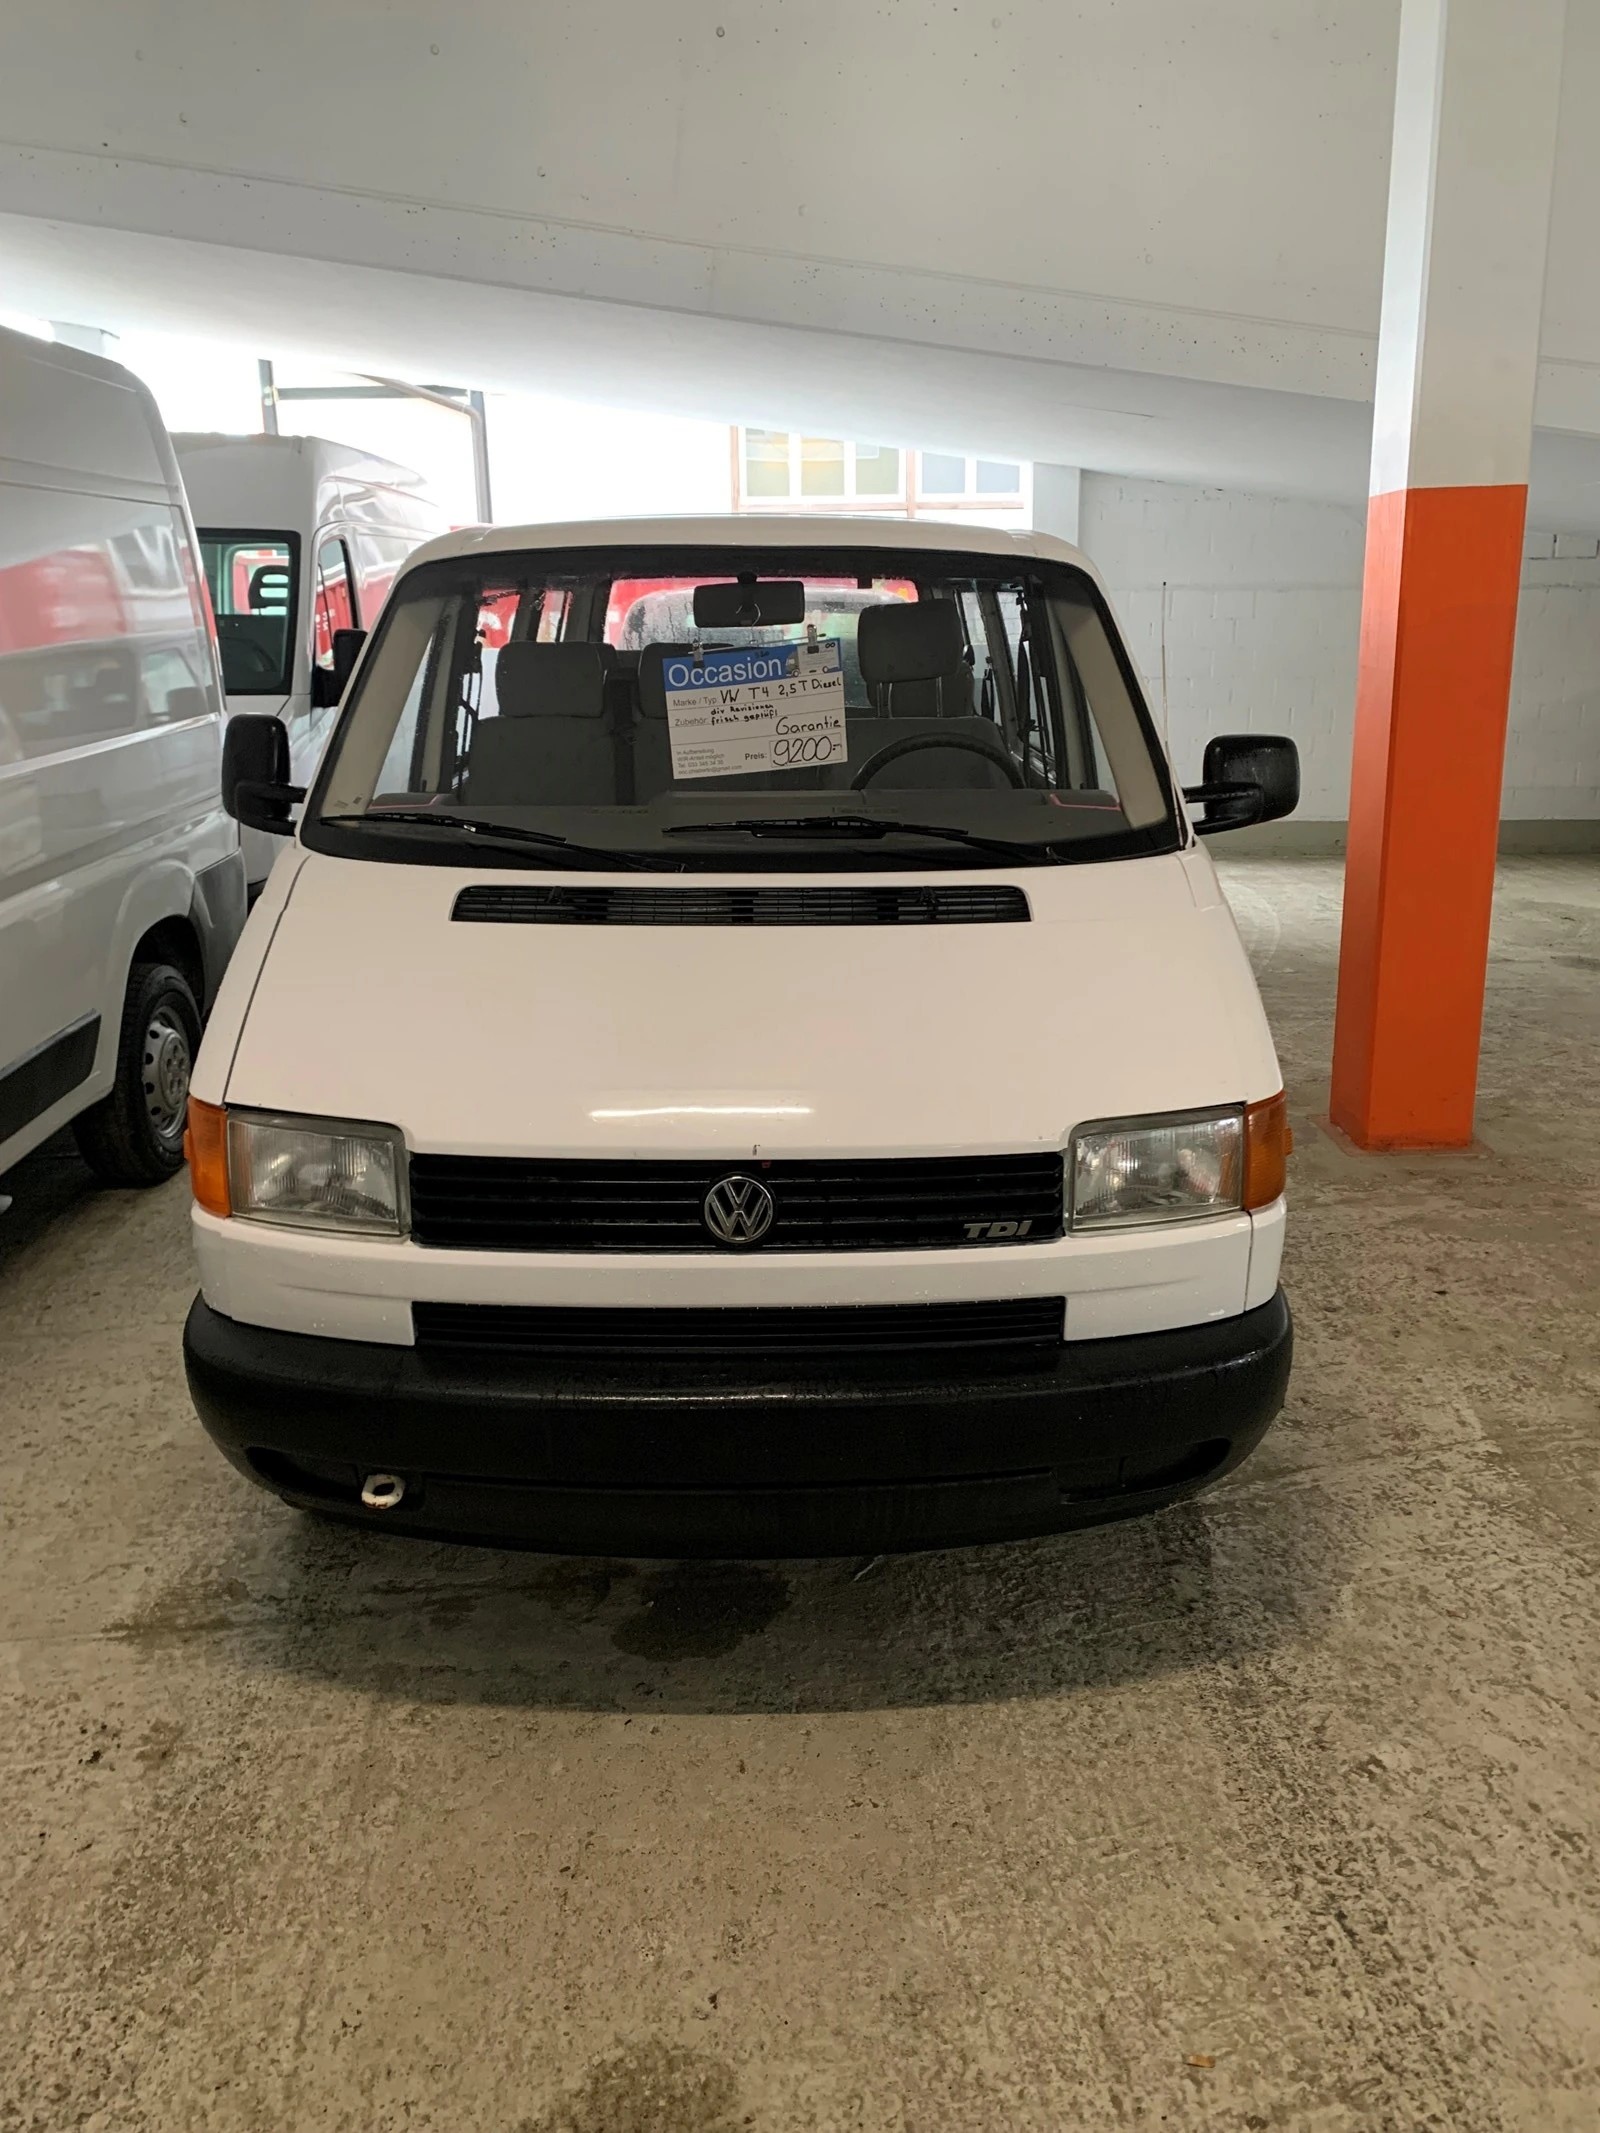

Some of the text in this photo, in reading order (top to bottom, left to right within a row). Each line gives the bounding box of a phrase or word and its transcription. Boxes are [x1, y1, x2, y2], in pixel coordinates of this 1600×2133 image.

[668, 657, 782, 687] Occasion
[720, 688, 740, 704] VW
[748, 687, 769, 699] T4
[778, 683, 797, 697] 2,5
[812, 677, 842, 690] Diesel
[673, 698, 697, 707] Marke
[711, 703, 774, 716] div Revisionen
[711, 714, 739, 726] frisch
[776, 715, 841, 735] Garantie
[744, 752, 768, 761] Preis:
[963, 1220, 1033, 1239] TDI
